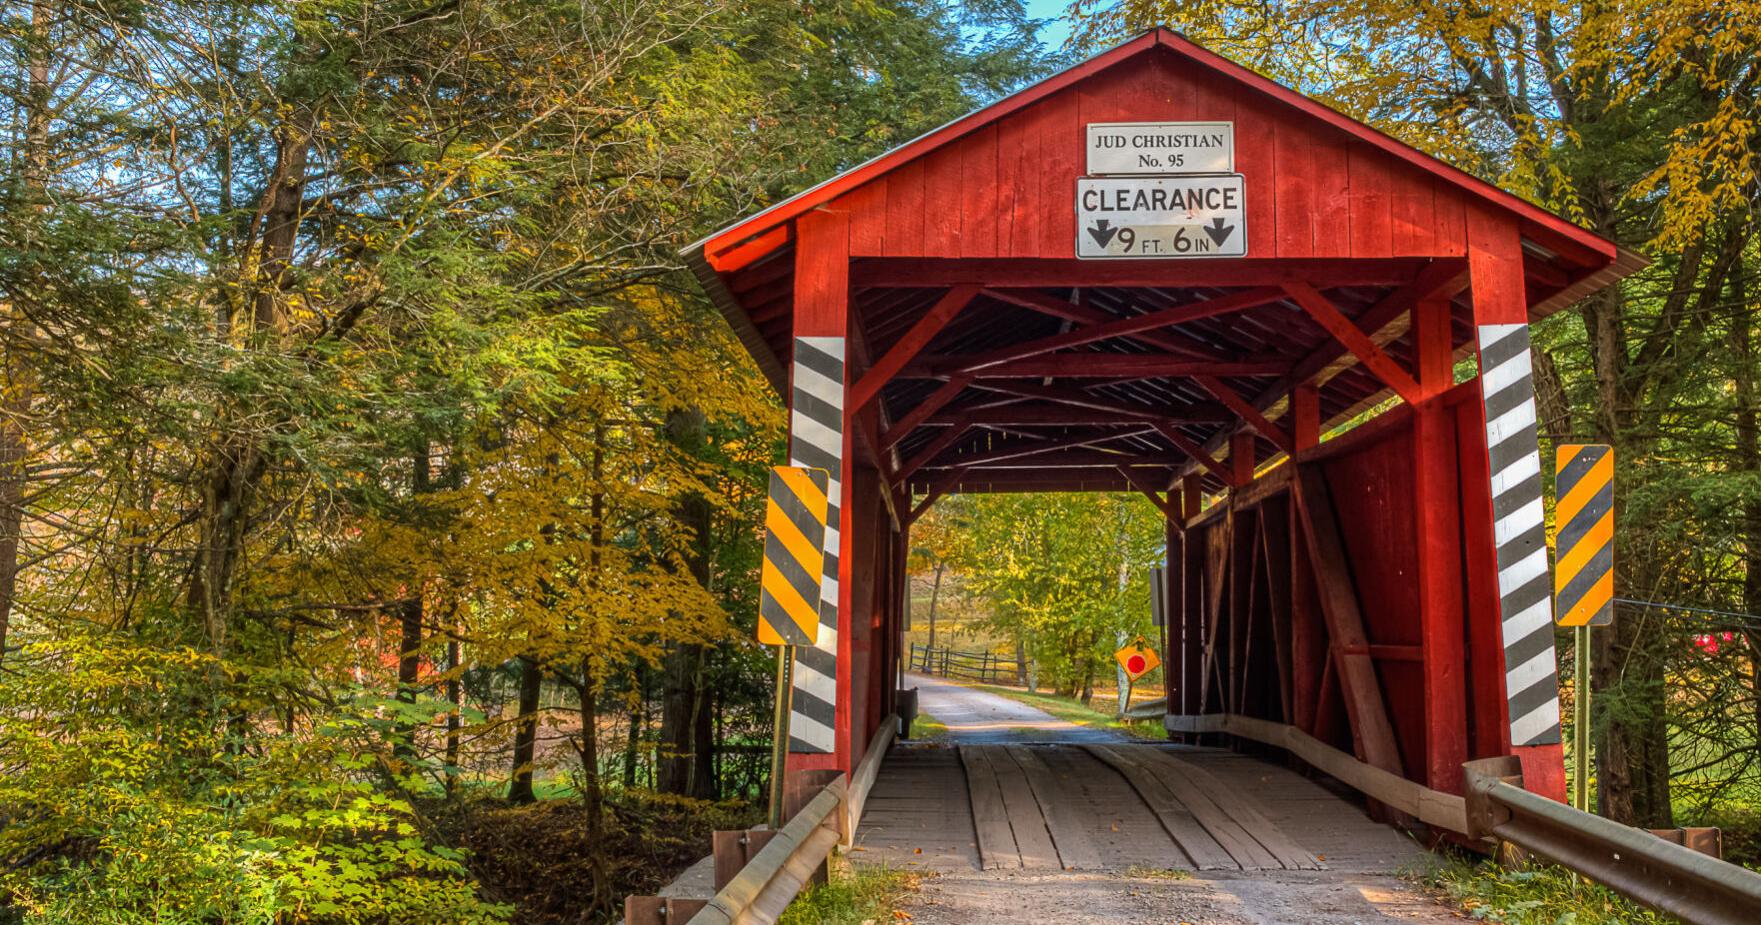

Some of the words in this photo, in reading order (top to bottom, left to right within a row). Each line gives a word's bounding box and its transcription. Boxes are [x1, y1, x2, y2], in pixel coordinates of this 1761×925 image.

[1095, 135, 1127, 148] JUD
[1132, 134, 1224, 148] CHRISTIAN
[1138, 155, 1162, 168] No.
[1168, 154, 1184, 167] 95
[1083, 187, 1238, 212] CLEARANCE
[1117, 227, 1136, 253] 9
[1142, 239, 1164, 254] FT.
[1173, 227, 1192, 253] 6
[1195, 238, 1209, 252] IN
